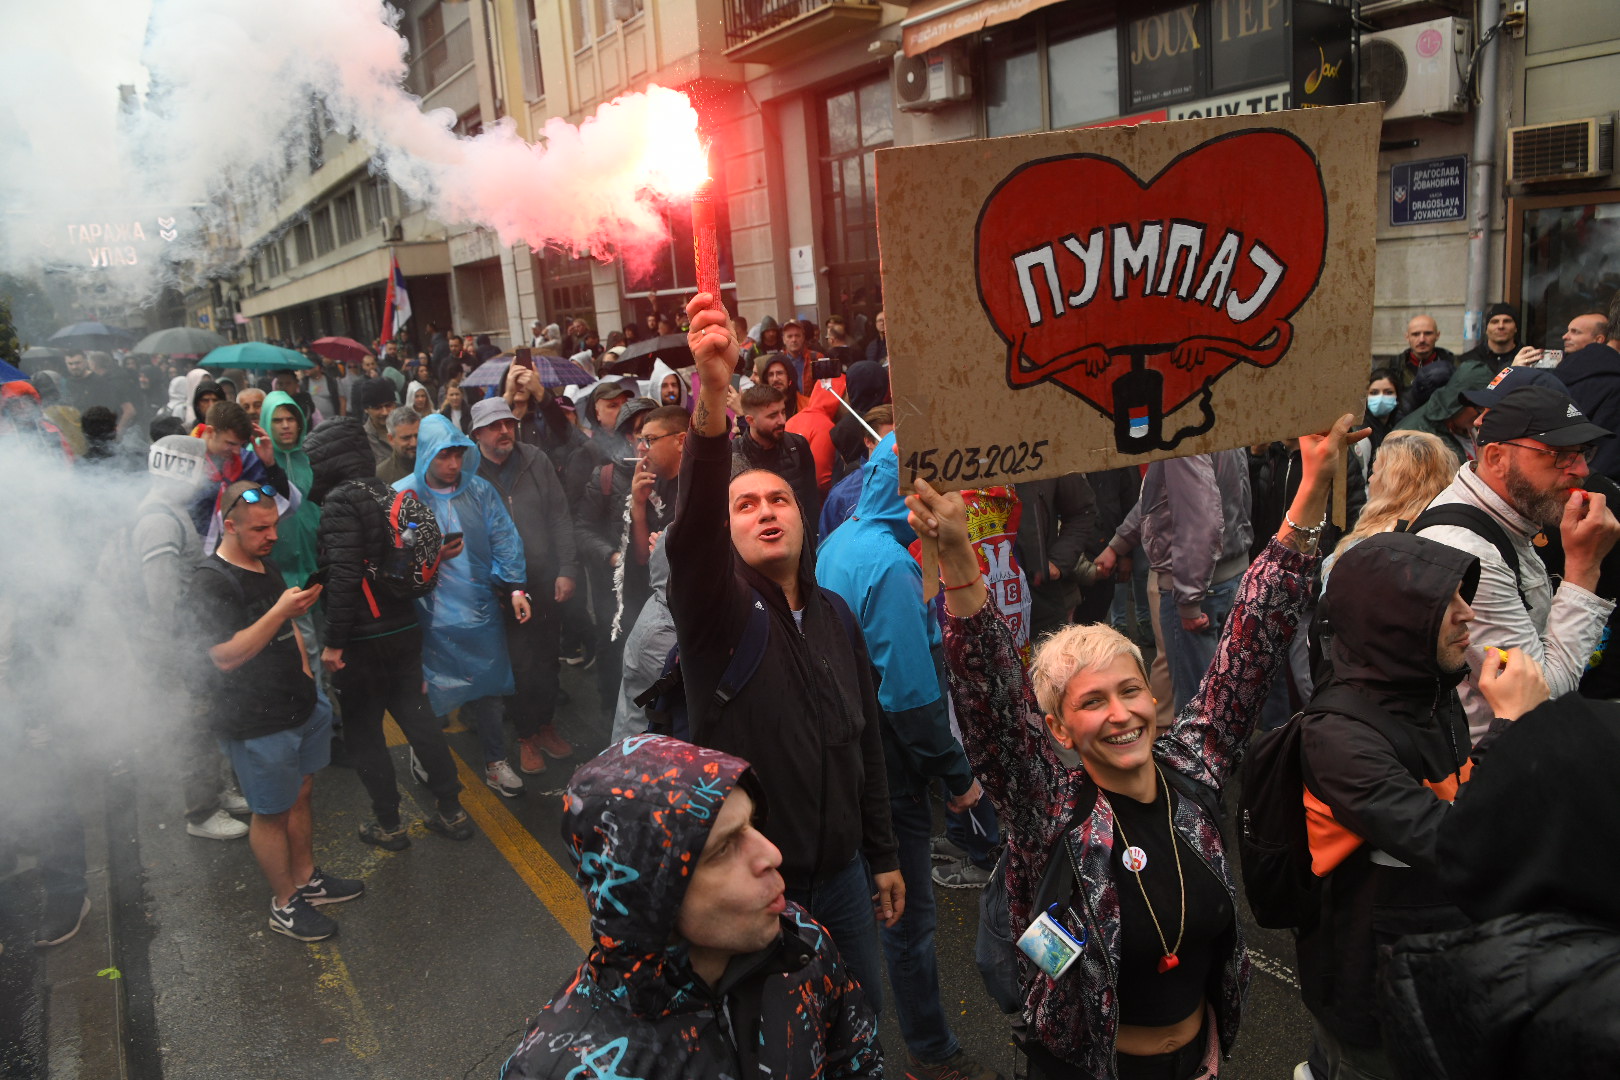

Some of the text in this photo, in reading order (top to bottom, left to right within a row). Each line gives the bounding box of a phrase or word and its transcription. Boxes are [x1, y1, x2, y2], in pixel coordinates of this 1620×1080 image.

[1131, 0, 1290, 65] JOUX TEP
[1413, 166, 1460, 181] ДРАГОСЛАВА
[1413, 176, 1460, 191] ЈОВАНОВИЋА
[1412, 197, 1460, 211] DRAGOSLAVA
[67, 221, 146, 244] ГАРАЖА
[88, 246, 138, 268] УЛАЗ
[1012, 218, 1287, 326] ПУМПАЈ
[153, 451, 197, 479] OVER
[904, 439, 1049, 485] 15.03.2025
